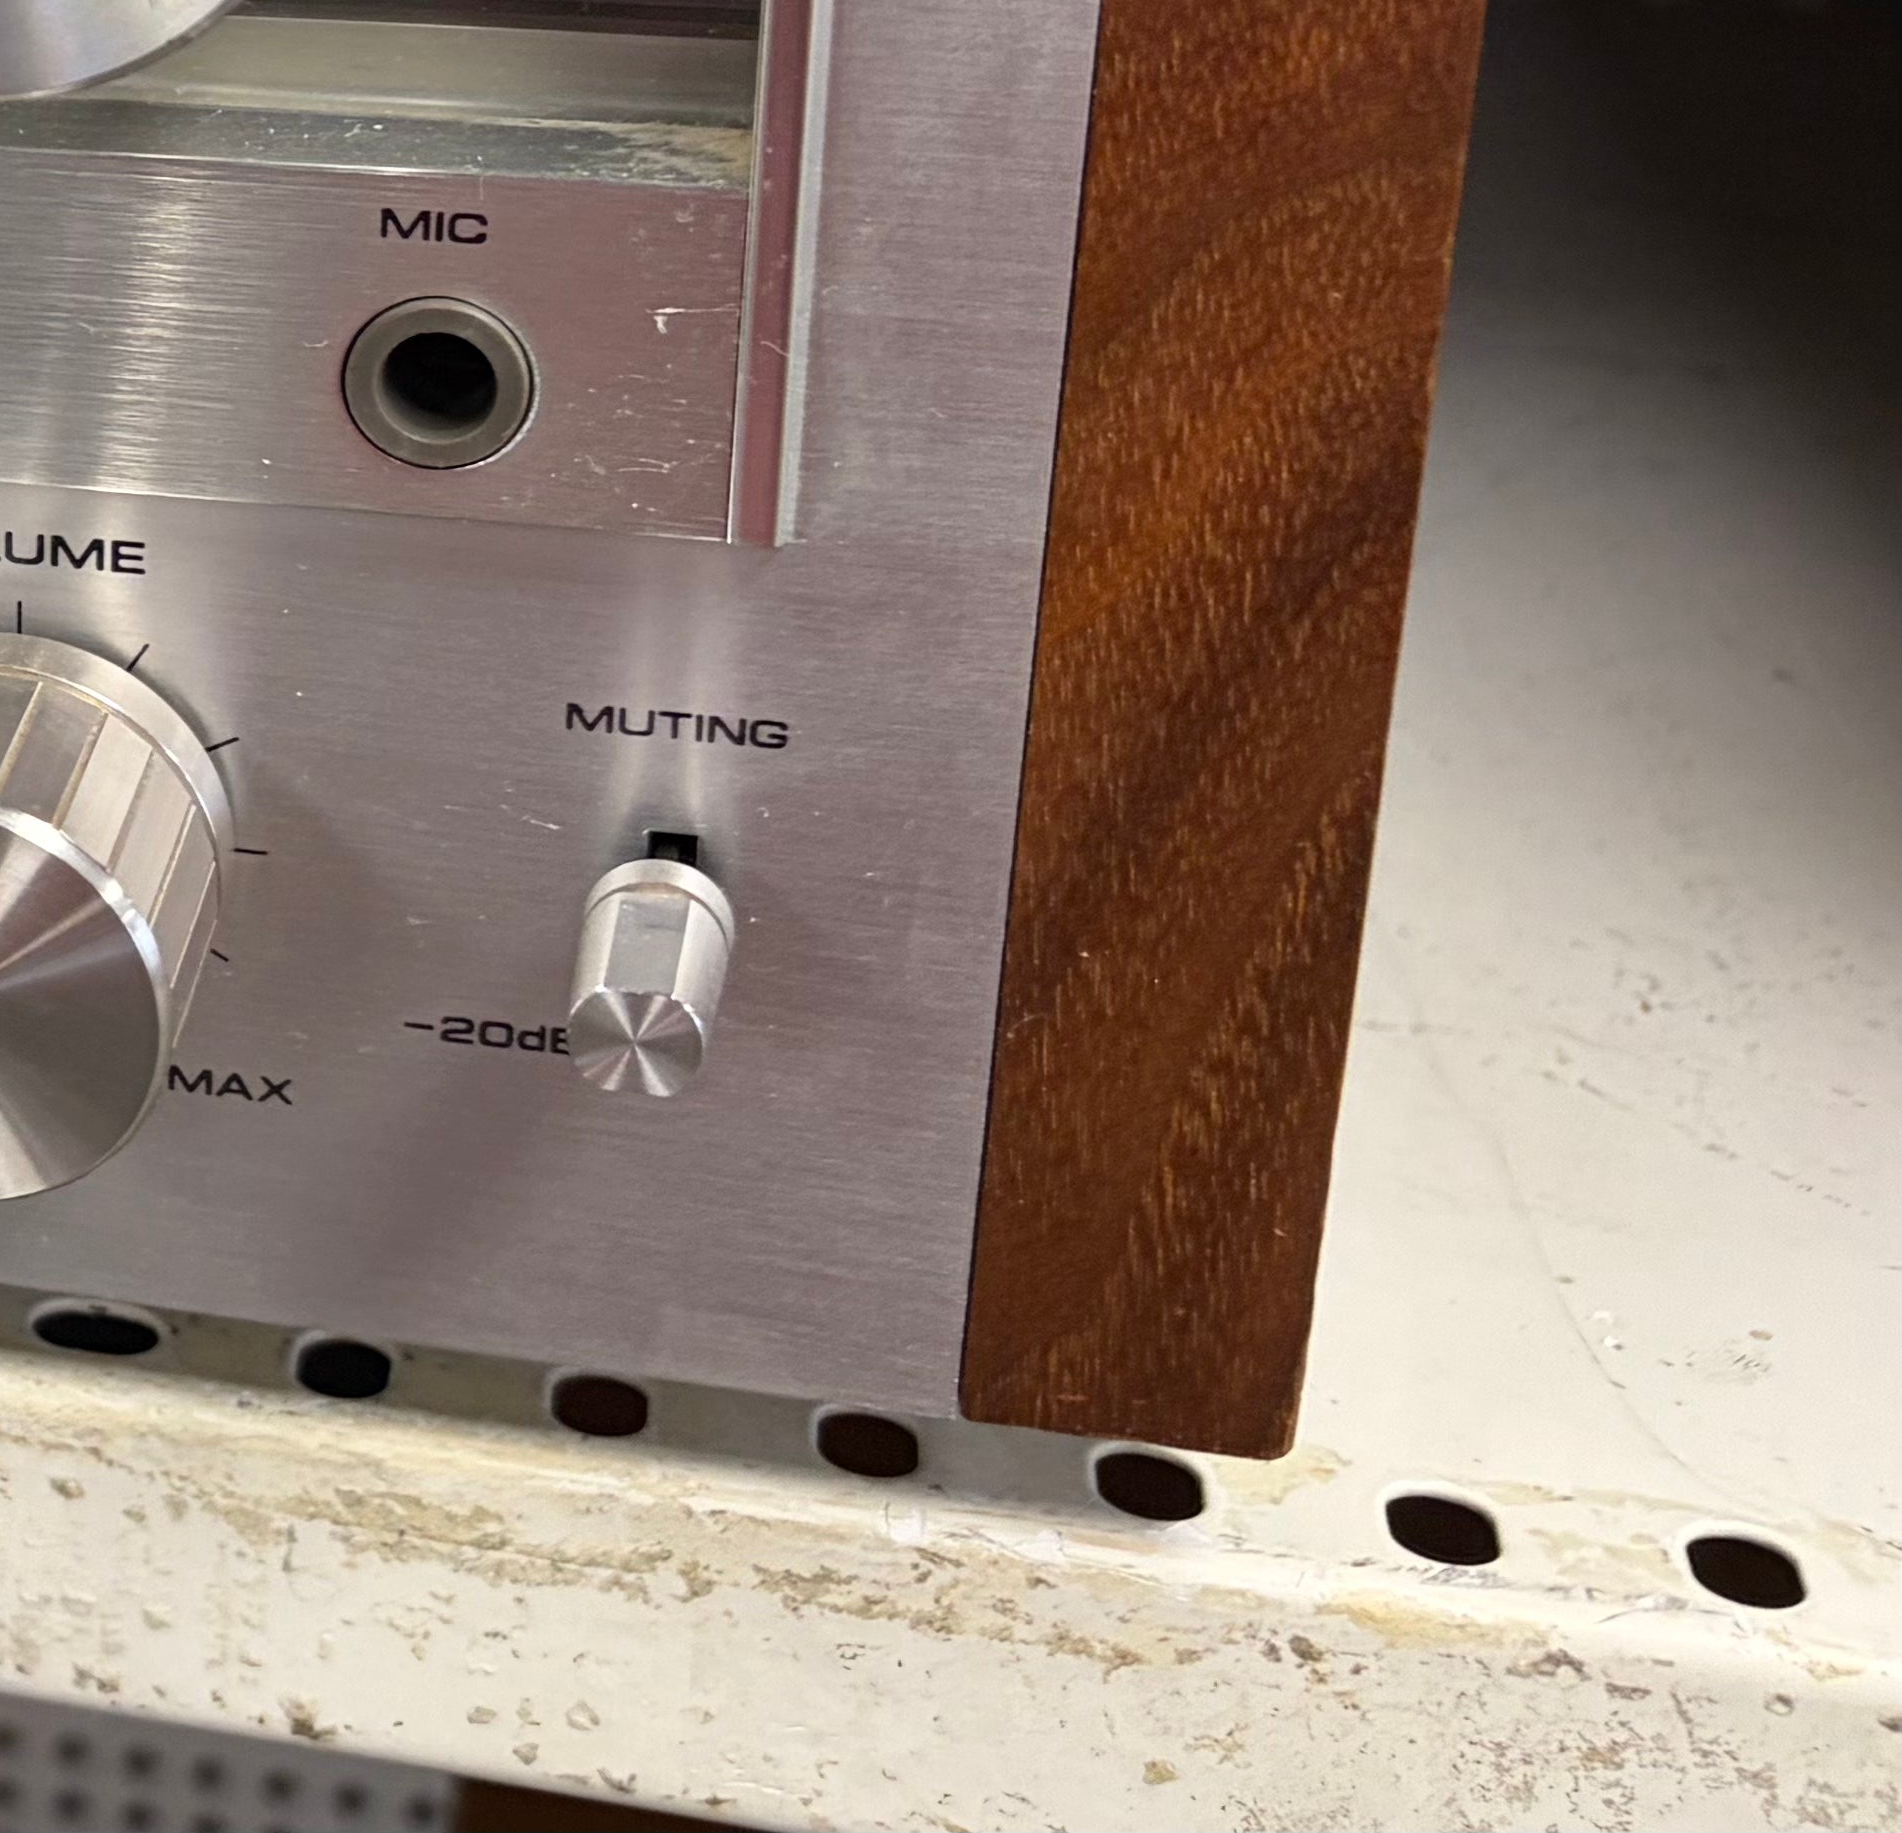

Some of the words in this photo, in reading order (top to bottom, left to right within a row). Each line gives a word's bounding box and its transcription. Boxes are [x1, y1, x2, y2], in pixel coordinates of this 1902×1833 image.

[380, 208, 488, 244] MIC
[566, 702, 789, 751] MUTING
[167, 1065, 293, 1106] MAX
